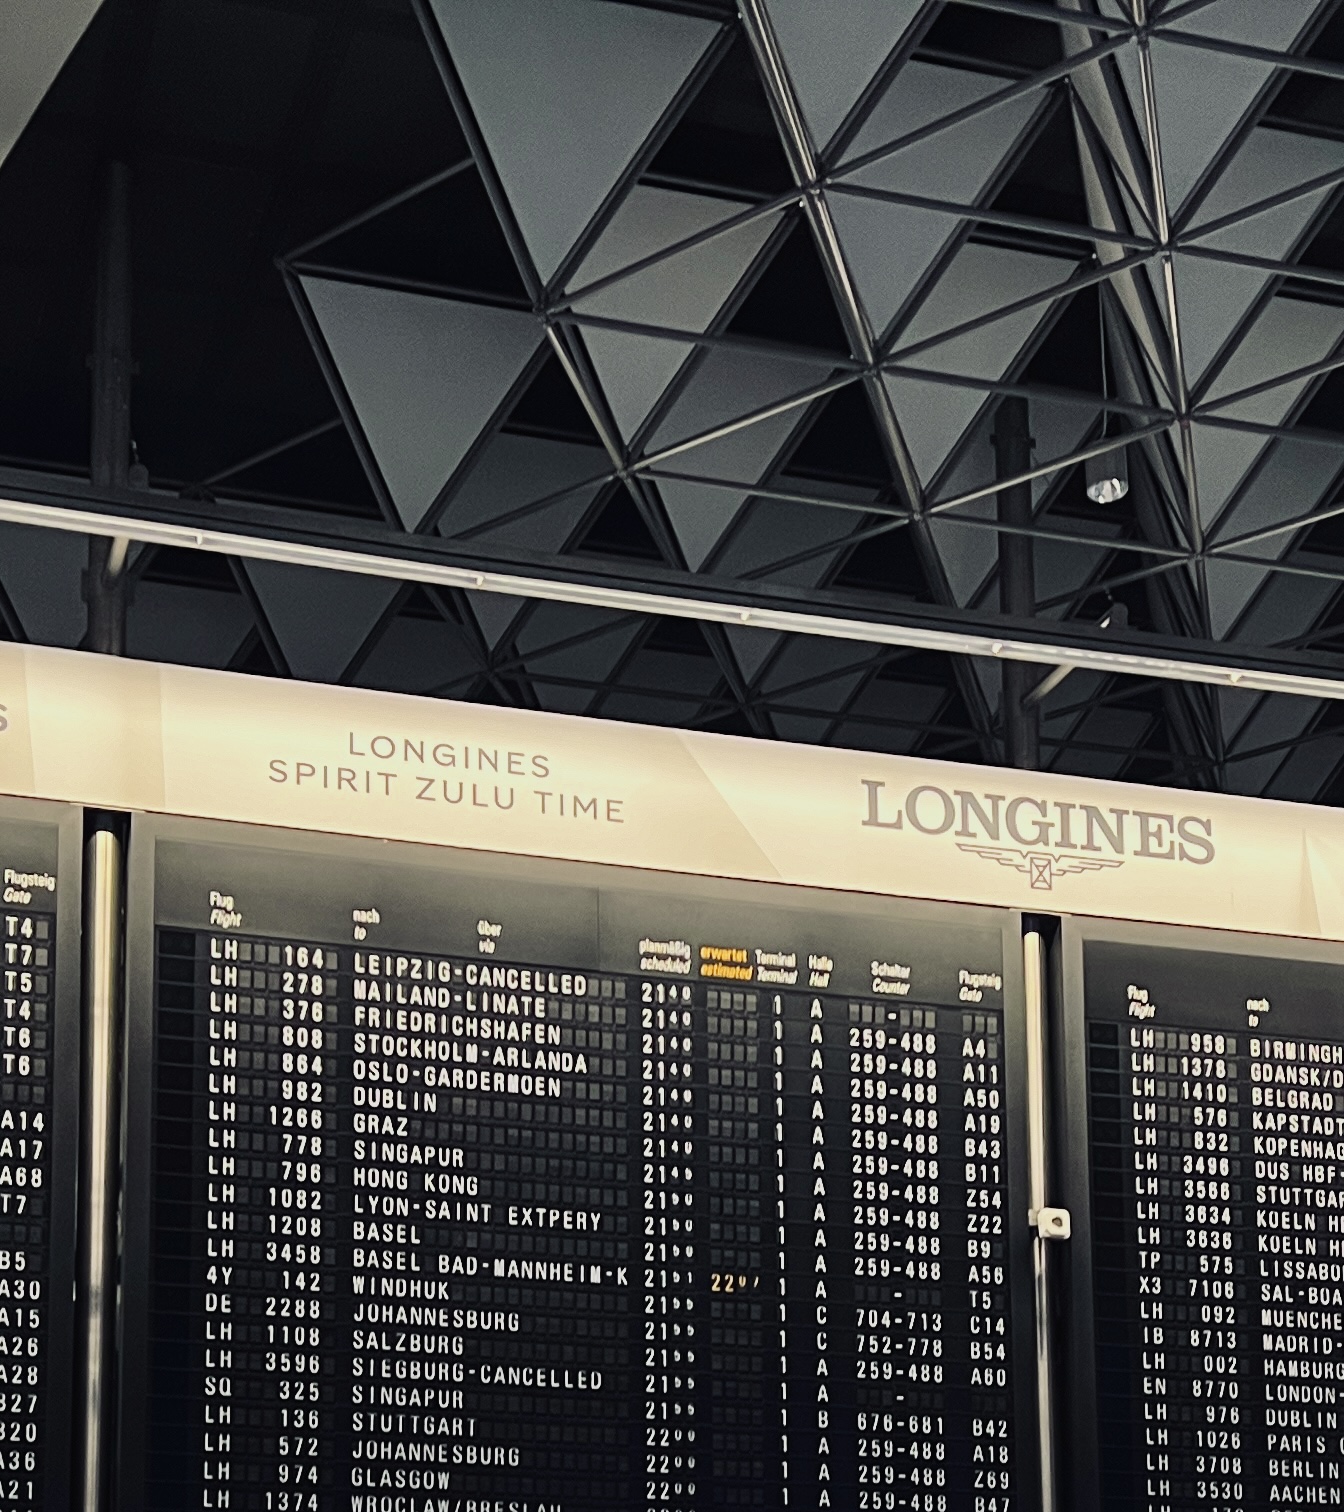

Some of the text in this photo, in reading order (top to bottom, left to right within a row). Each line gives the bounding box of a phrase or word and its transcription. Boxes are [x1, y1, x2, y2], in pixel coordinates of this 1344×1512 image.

[348, 732, 550, 778] LONGINES
[268, 759, 625, 824] SPIRIT ZULU TIME
[862, 780, 1215, 867] LONGINES
[281, 1051, 323, 1076] 864
[352, 1058, 561, 1098] OSLO-GARDERMOEN
[963, 1112, 1000, 1134] A19
[1181, 1080, 1227, 1103] 1410
[1250, 1085, 1333, 1112] BELGRAD
[0, 1108, 45, 1132] A14
[280, 1159, 1002, 1235] 796 HONG KONG Z22
[1142, 1375, 1166, 1395] EN
[1191, 1378, 1239, 1399] 8770
[265, 1490, 318, 1512] 1374
